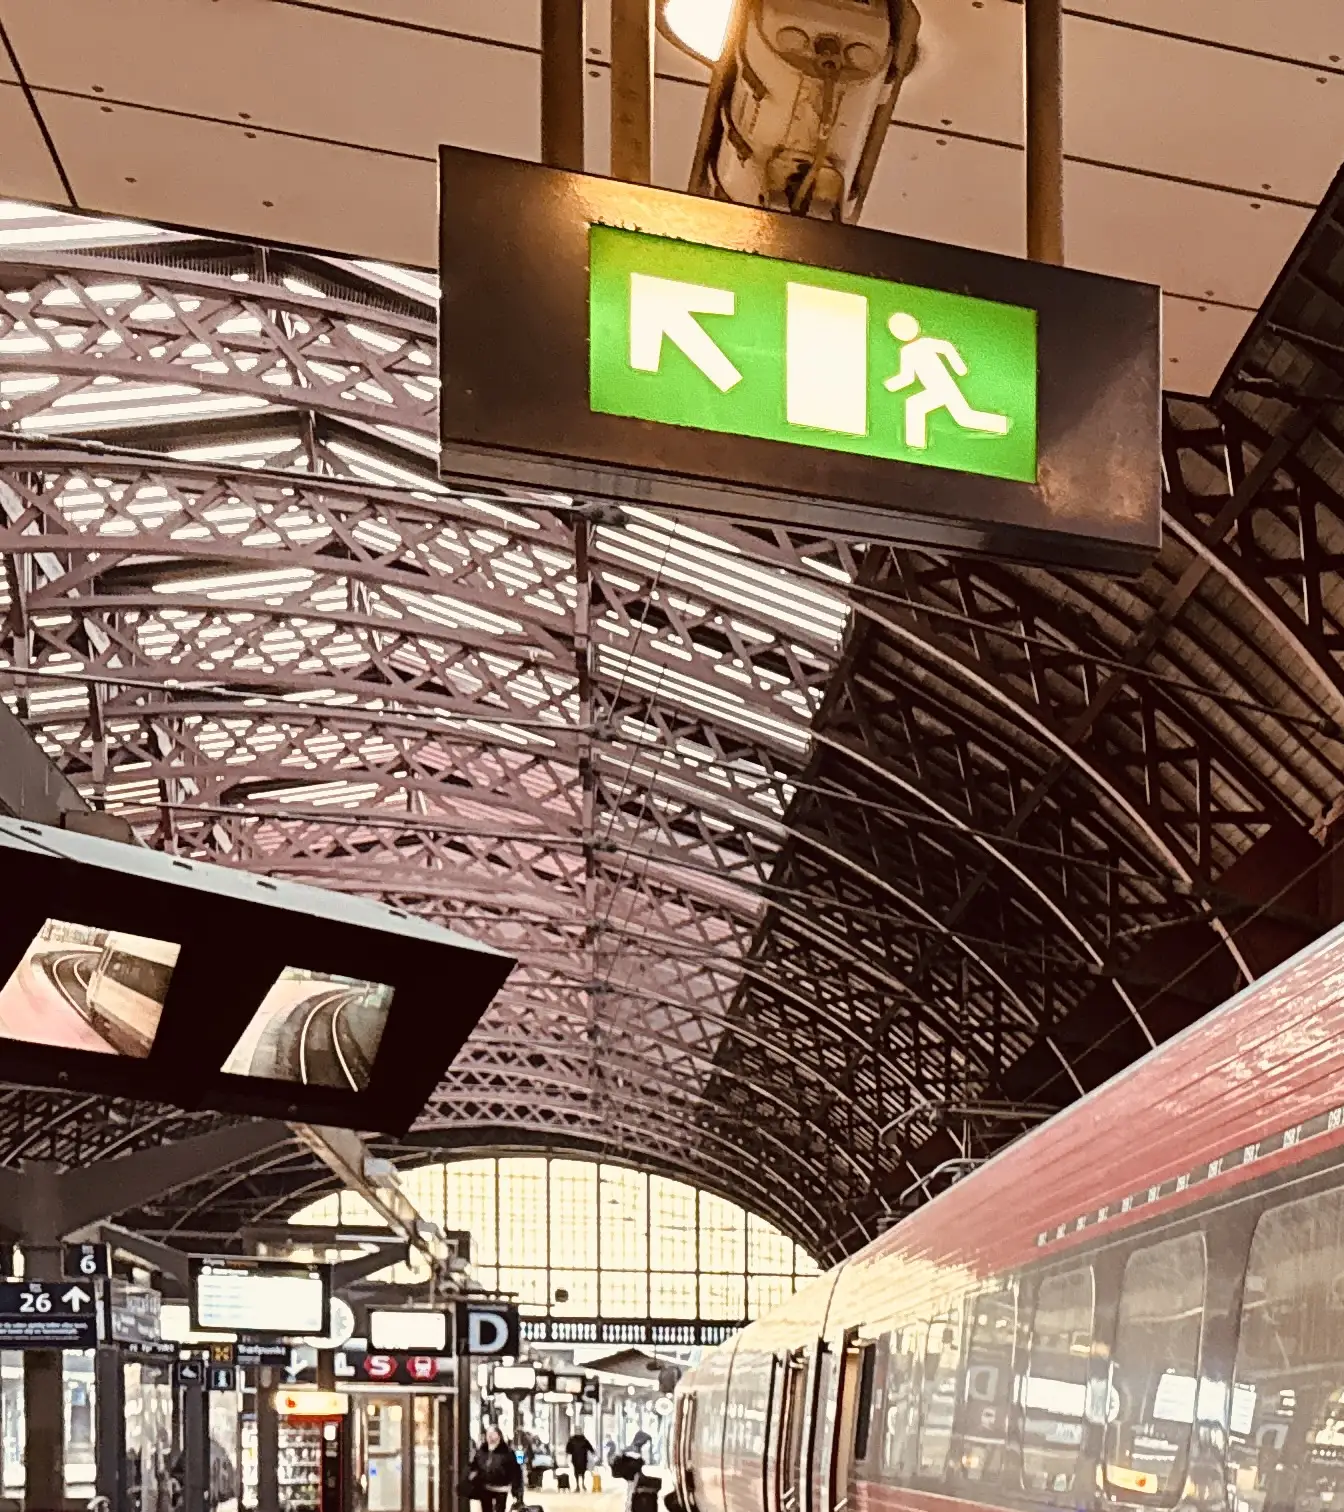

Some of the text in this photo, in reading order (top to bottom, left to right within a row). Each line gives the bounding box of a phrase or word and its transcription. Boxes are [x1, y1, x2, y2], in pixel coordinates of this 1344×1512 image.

[80, 1255, 97, 1274] 6
[19, 1292, 52, 1313] 26
[469, 1312, 509, 1353] D
[370, 1355, 391, 1376] S
